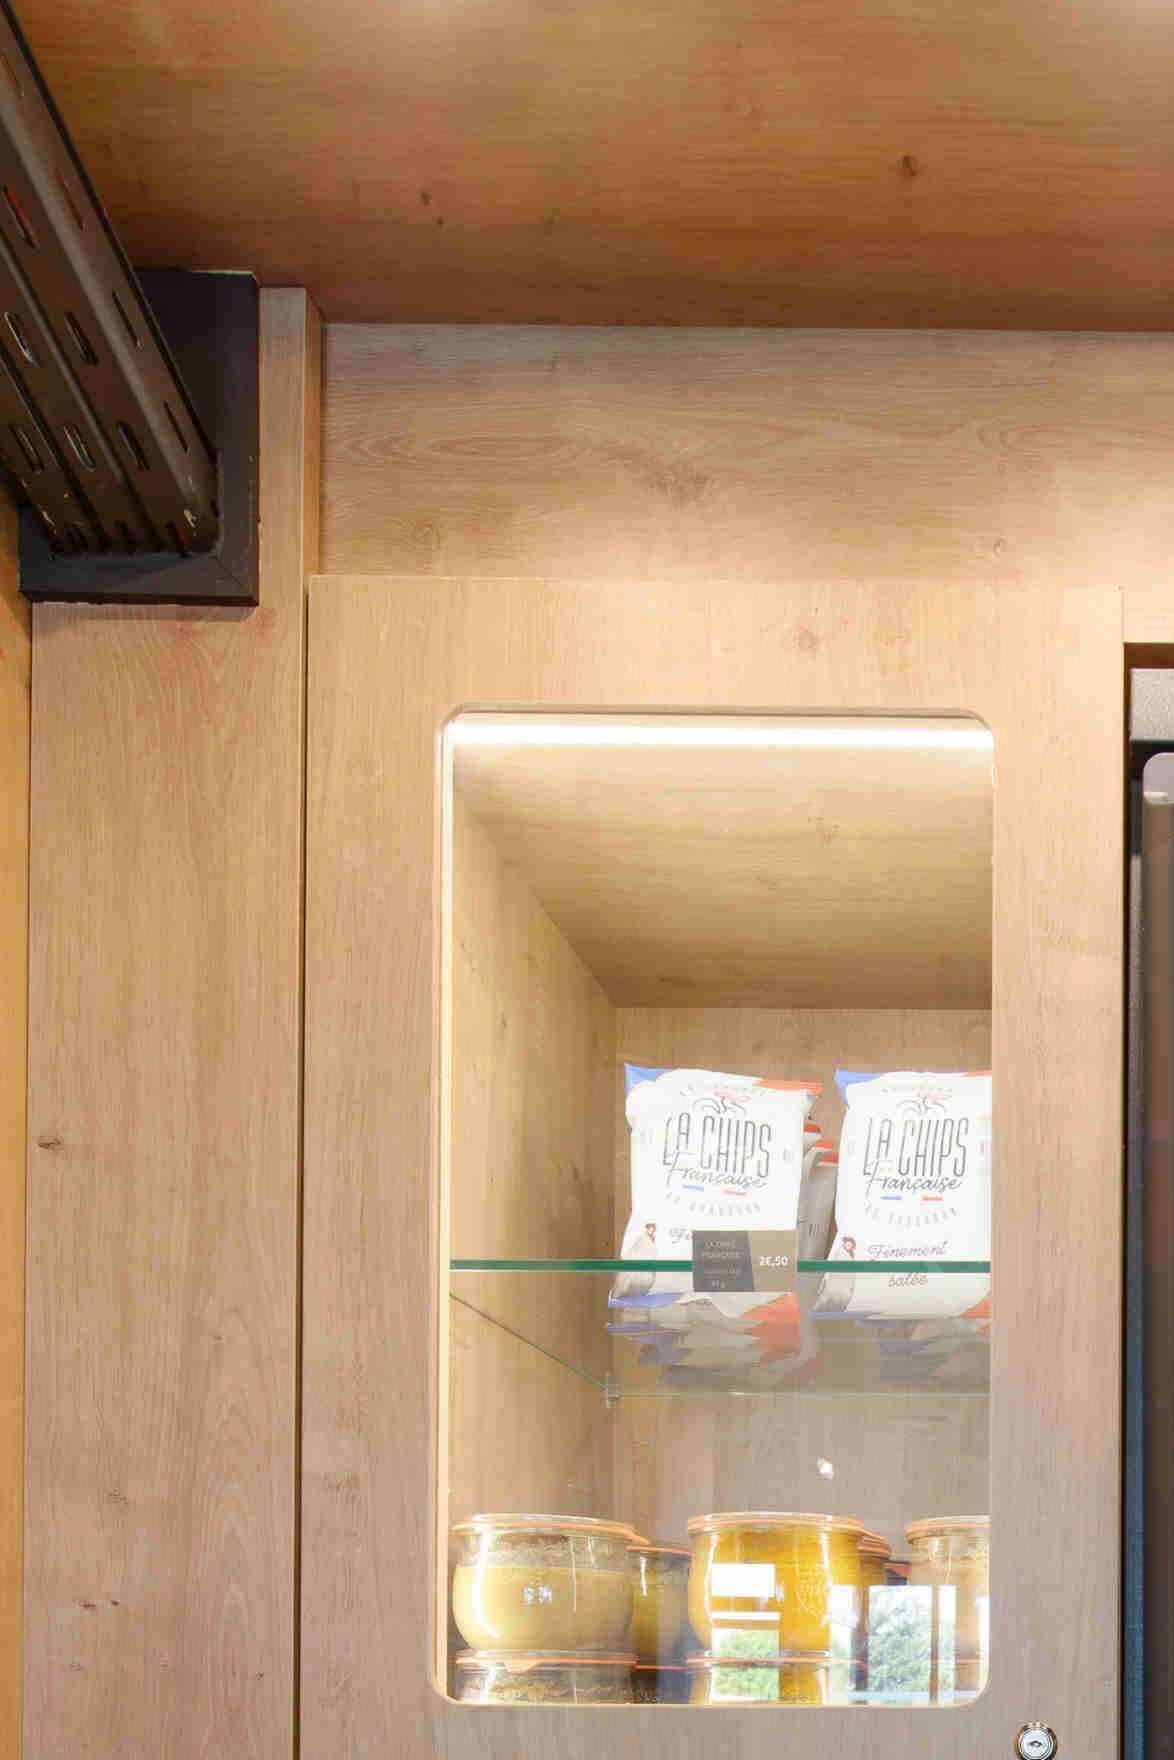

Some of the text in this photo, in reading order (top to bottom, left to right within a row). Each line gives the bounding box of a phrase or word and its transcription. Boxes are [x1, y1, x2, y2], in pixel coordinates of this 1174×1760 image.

[662, 1111, 773, 1179] LA CHIPS
[862, 1116, 969, 1178] LA CHIPS
